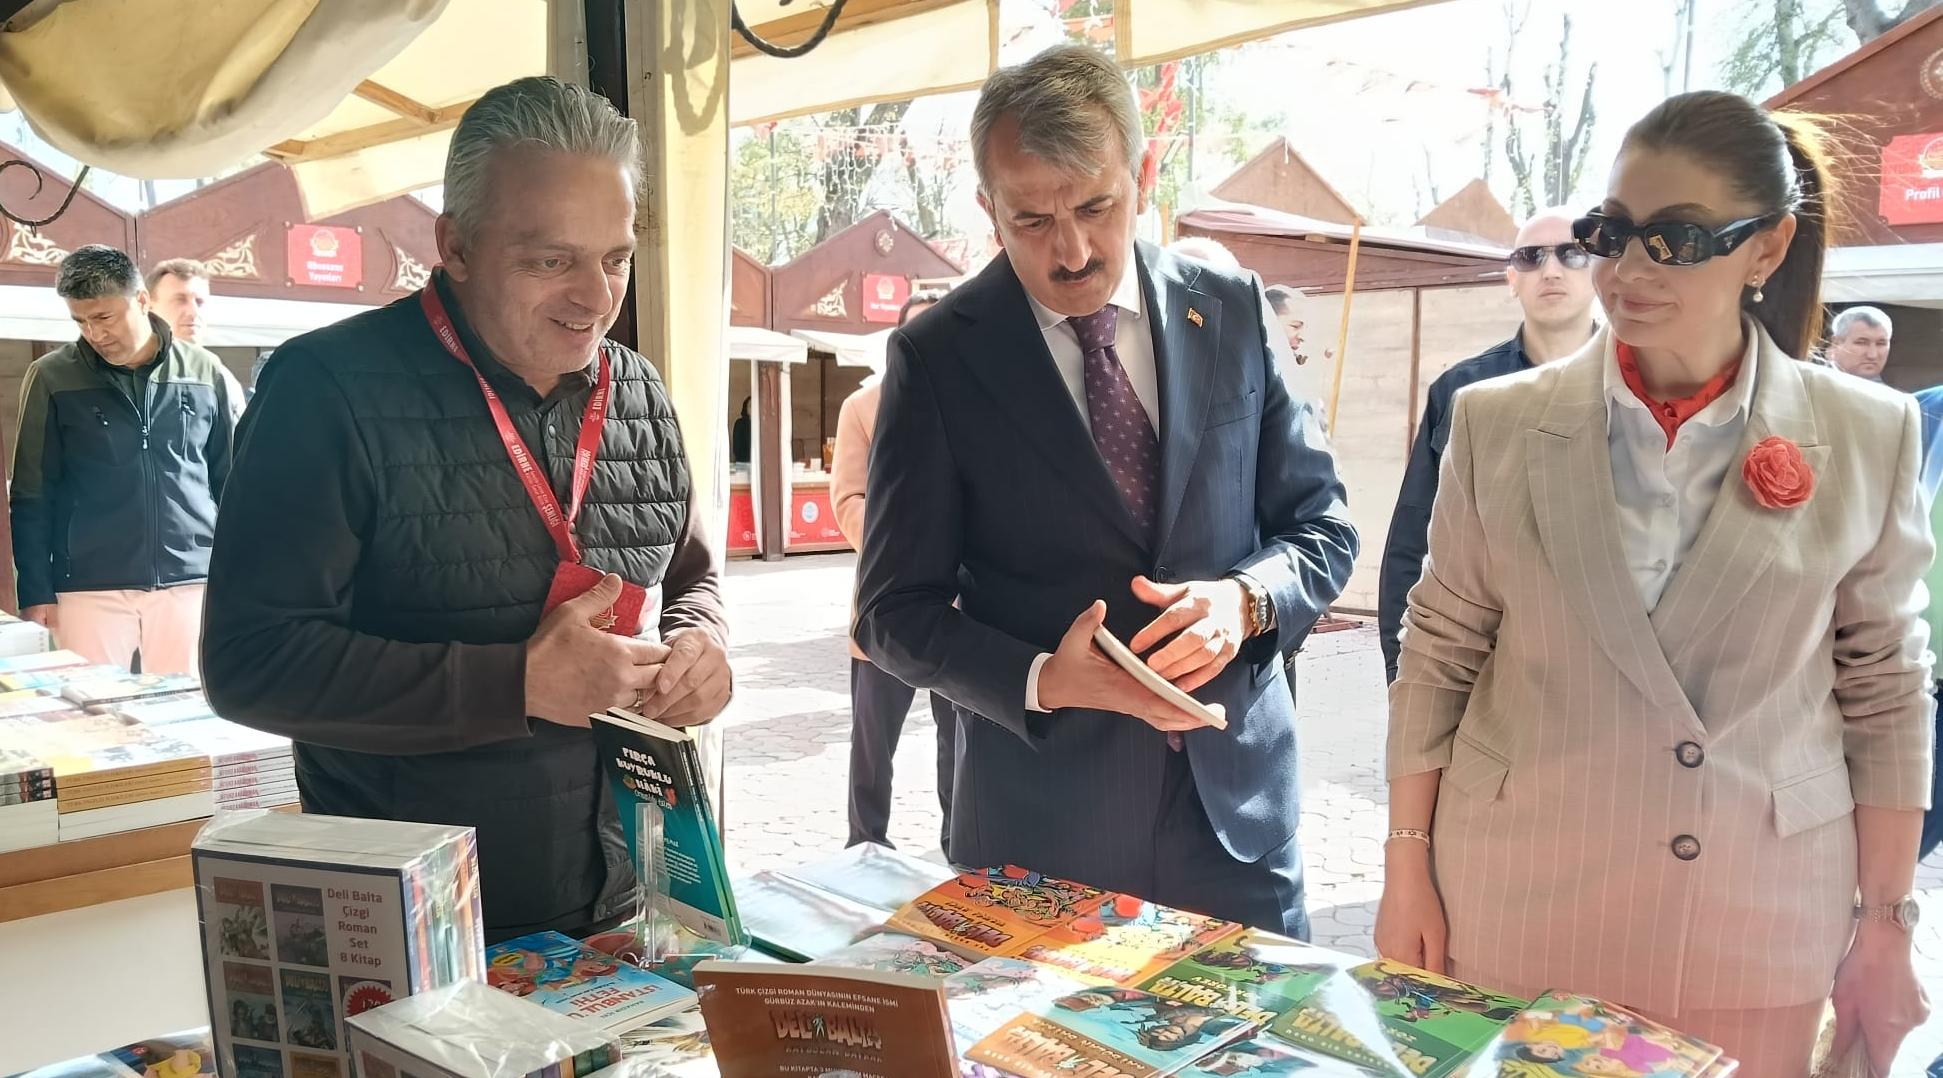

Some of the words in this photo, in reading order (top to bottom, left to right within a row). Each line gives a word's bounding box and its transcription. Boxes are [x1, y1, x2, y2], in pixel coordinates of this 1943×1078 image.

[1905, 187, 1940, 201] Profil
[511, 444, 533, 473] EDİRNE
[327, 888, 349, 900] Deli
[352, 891, 383, 903] Balta
[342, 907, 370, 920] Çizgi
[338, 920, 378, 935] Roman
[349, 938, 370, 949] Set
[340, 952, 348, 962] 8
[351, 953, 382, 968] Kitap
[570, 987, 620, 1007] FETHİ
[736, 987, 756, 995] TÜRK
[757, 987, 777, 997] ÇİZGİ
[778, 988, 805, 996] ROMAN
[806, 989, 851, 1000] DÜNYASININ
[852, 994, 881, 1005] EFSANE
[882, 996, 899, 1007] İSMİ
[1148, 976, 1222, 1008] BALTA
[764, 996, 796, 1006] GÜRBÜZ
[826, 1000, 875, 1013] KALEMİNDEN
[826, 1013, 882, 1049] BALTA
[780, 1064, 790, 1072] BU
